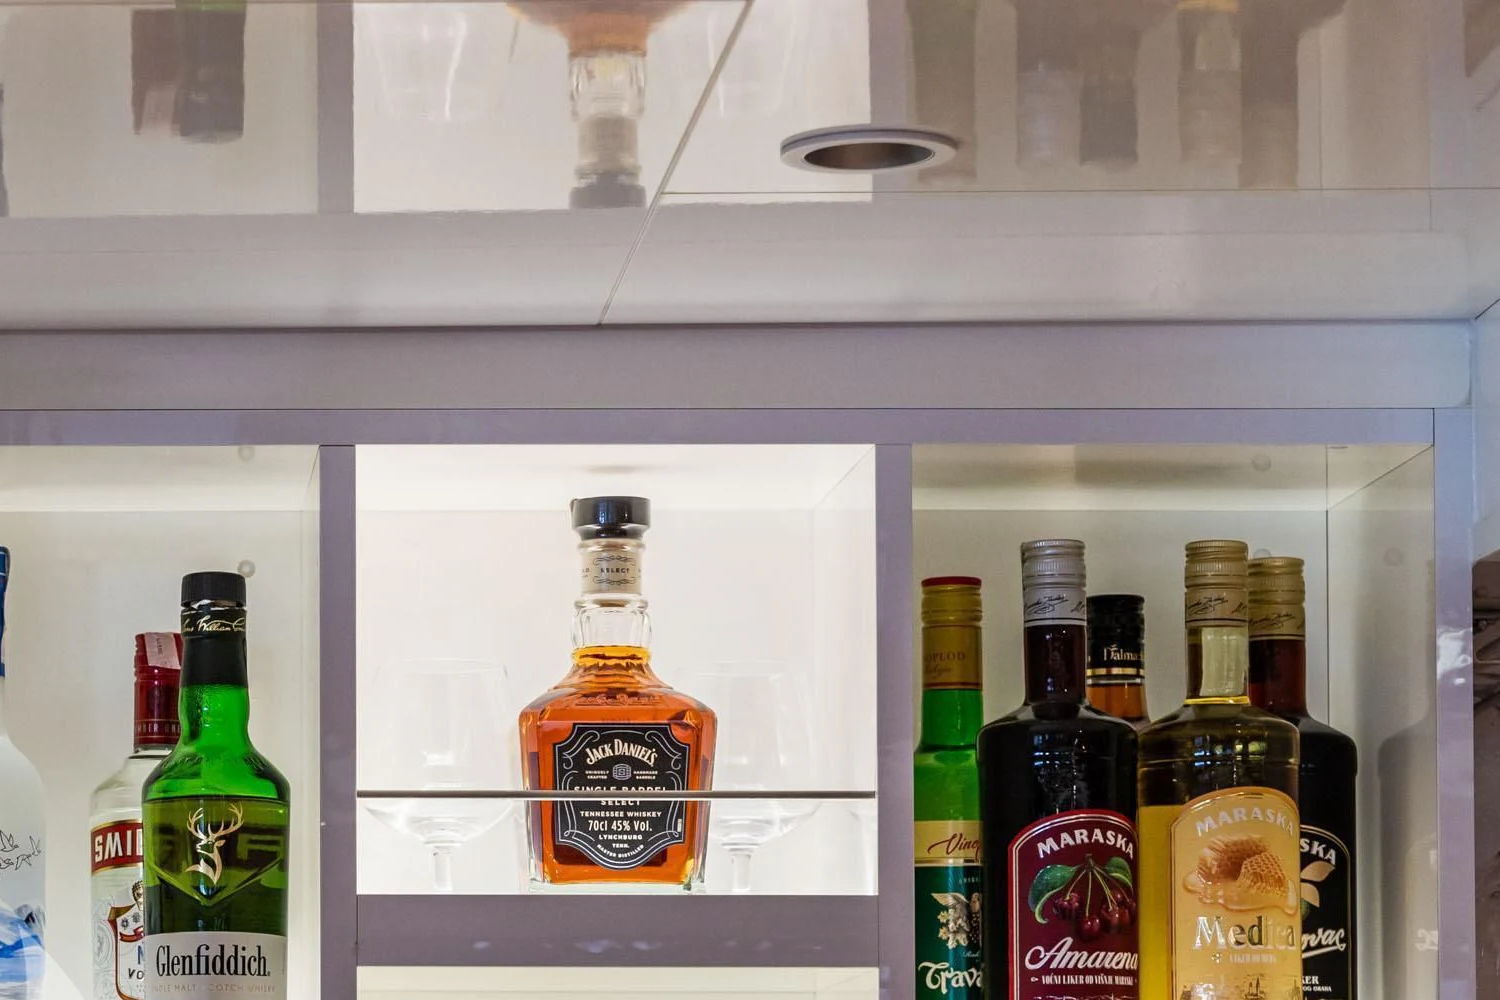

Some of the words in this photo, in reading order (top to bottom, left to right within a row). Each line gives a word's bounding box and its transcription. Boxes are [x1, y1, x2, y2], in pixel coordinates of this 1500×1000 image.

[585, 743, 613, 765] JACK
[588, 820, 608, 831] 70cl
[611, 820, 631, 831] 45%
[633, 820, 653, 831] Vol.
[1196, 807, 1295, 838] MARASKA
[1037, 828, 1135, 859] MARASKA
[1194, 915, 1297, 950] Medica
[156, 944, 268, 976] Glenfiddich
[1025, 936, 1138, 970] Amarena
